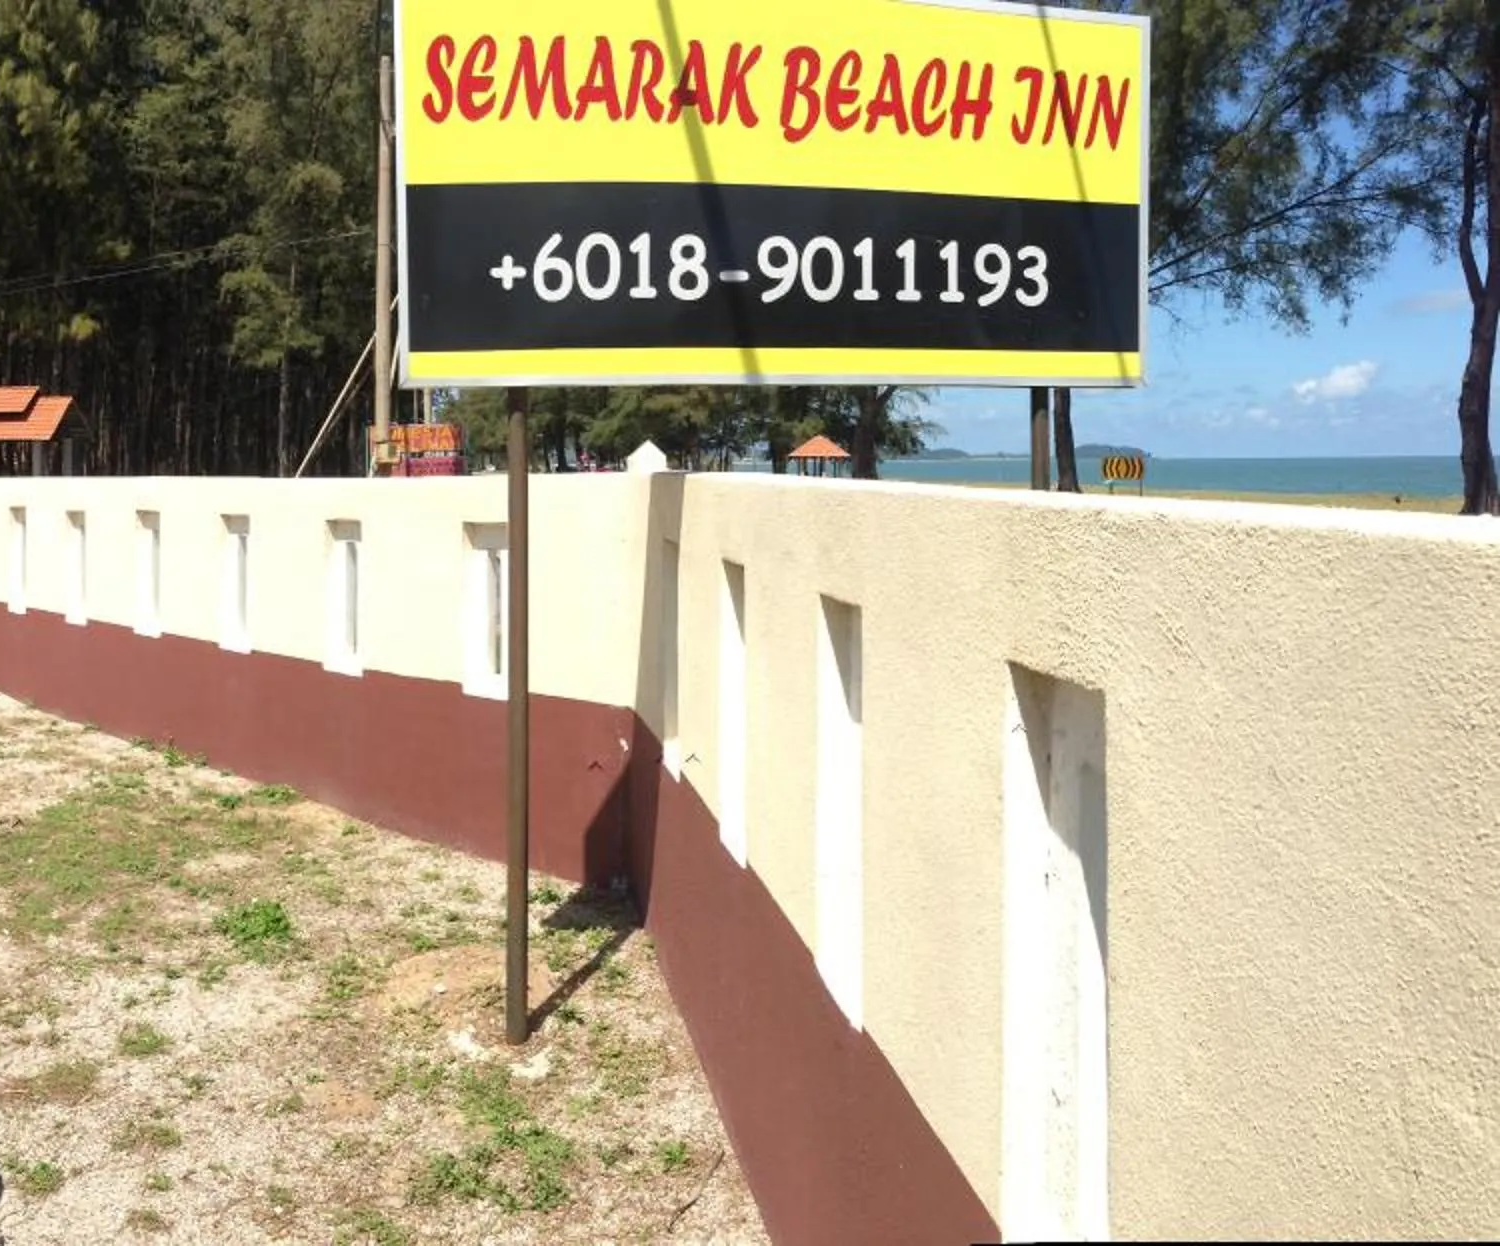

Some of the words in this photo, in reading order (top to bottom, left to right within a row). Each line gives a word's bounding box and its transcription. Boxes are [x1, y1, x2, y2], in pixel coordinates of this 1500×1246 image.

[422, 34, 763, 128] SEMARAK
[780, 45, 994, 143] BEACH
[489, 231, 1050, 308] +6018-9011193
